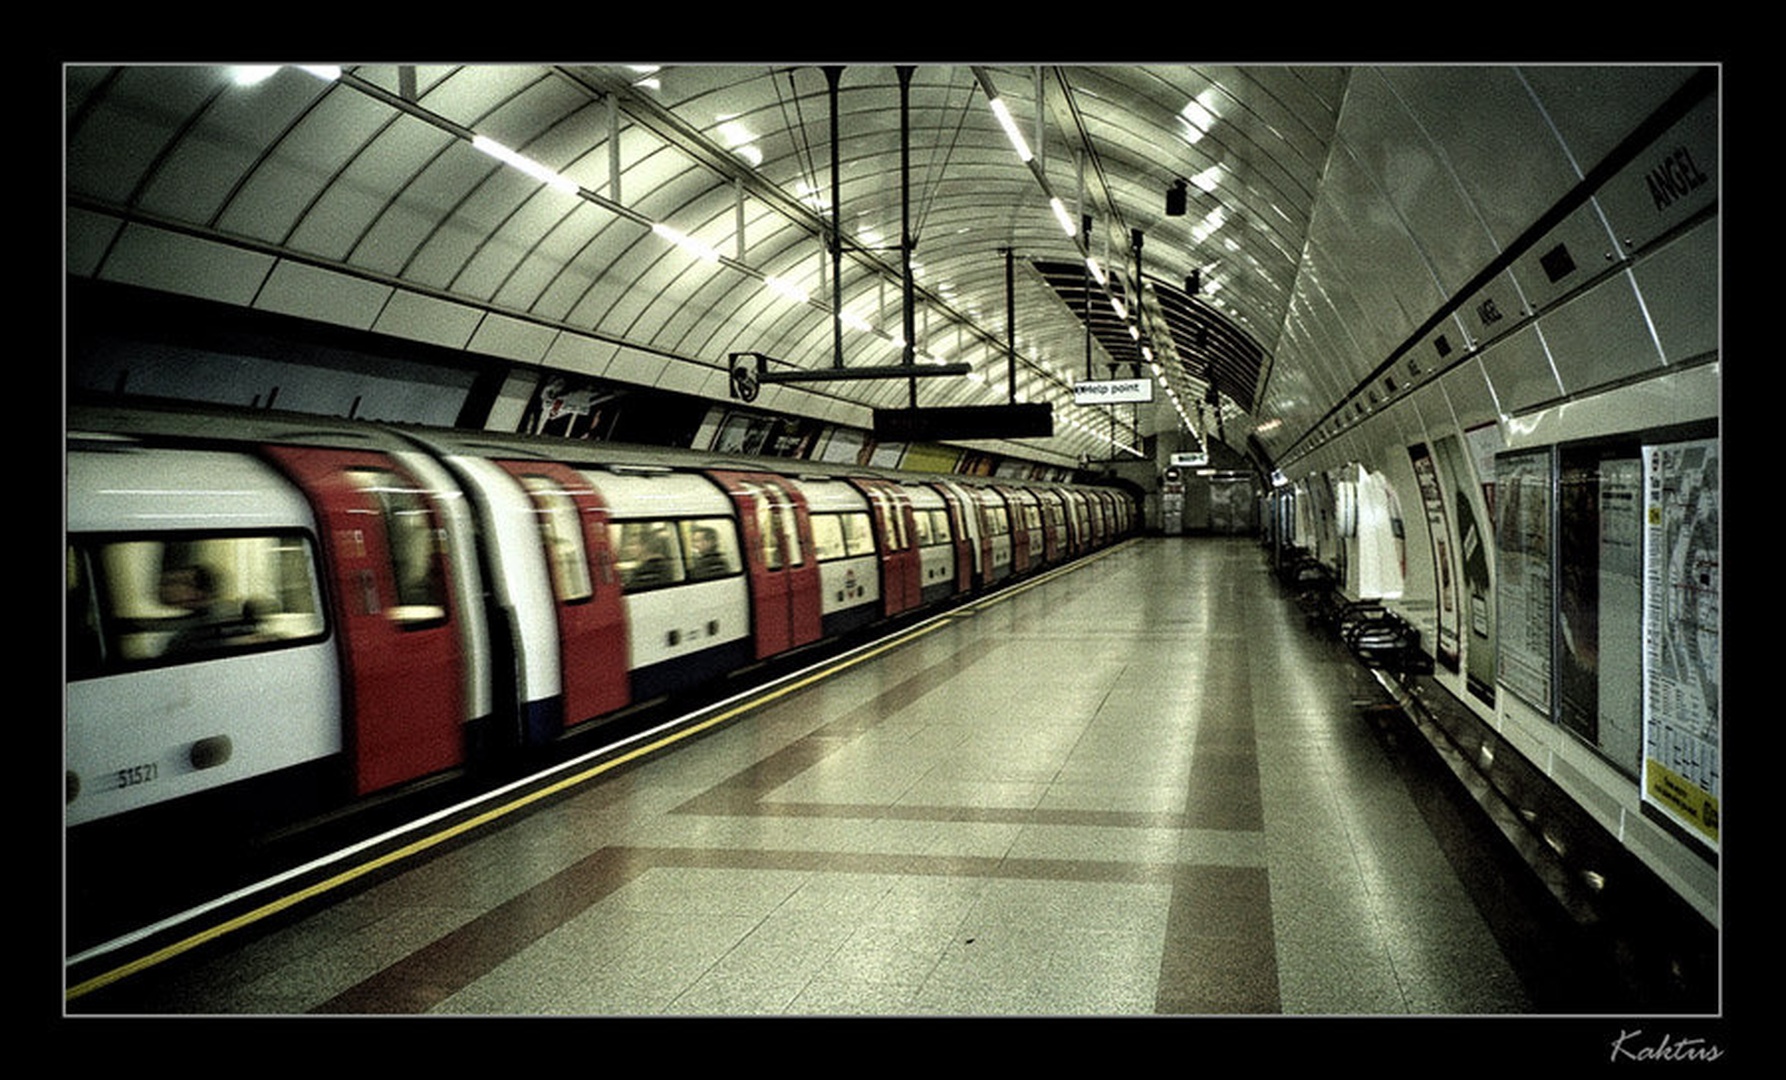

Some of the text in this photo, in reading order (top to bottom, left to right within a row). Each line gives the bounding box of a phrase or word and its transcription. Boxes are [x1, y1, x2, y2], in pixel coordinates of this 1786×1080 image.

[1645, 146, 1709, 212] ANGEL
[1085, 383, 1140, 395] Help point
[117, 762, 158, 789] 51521
